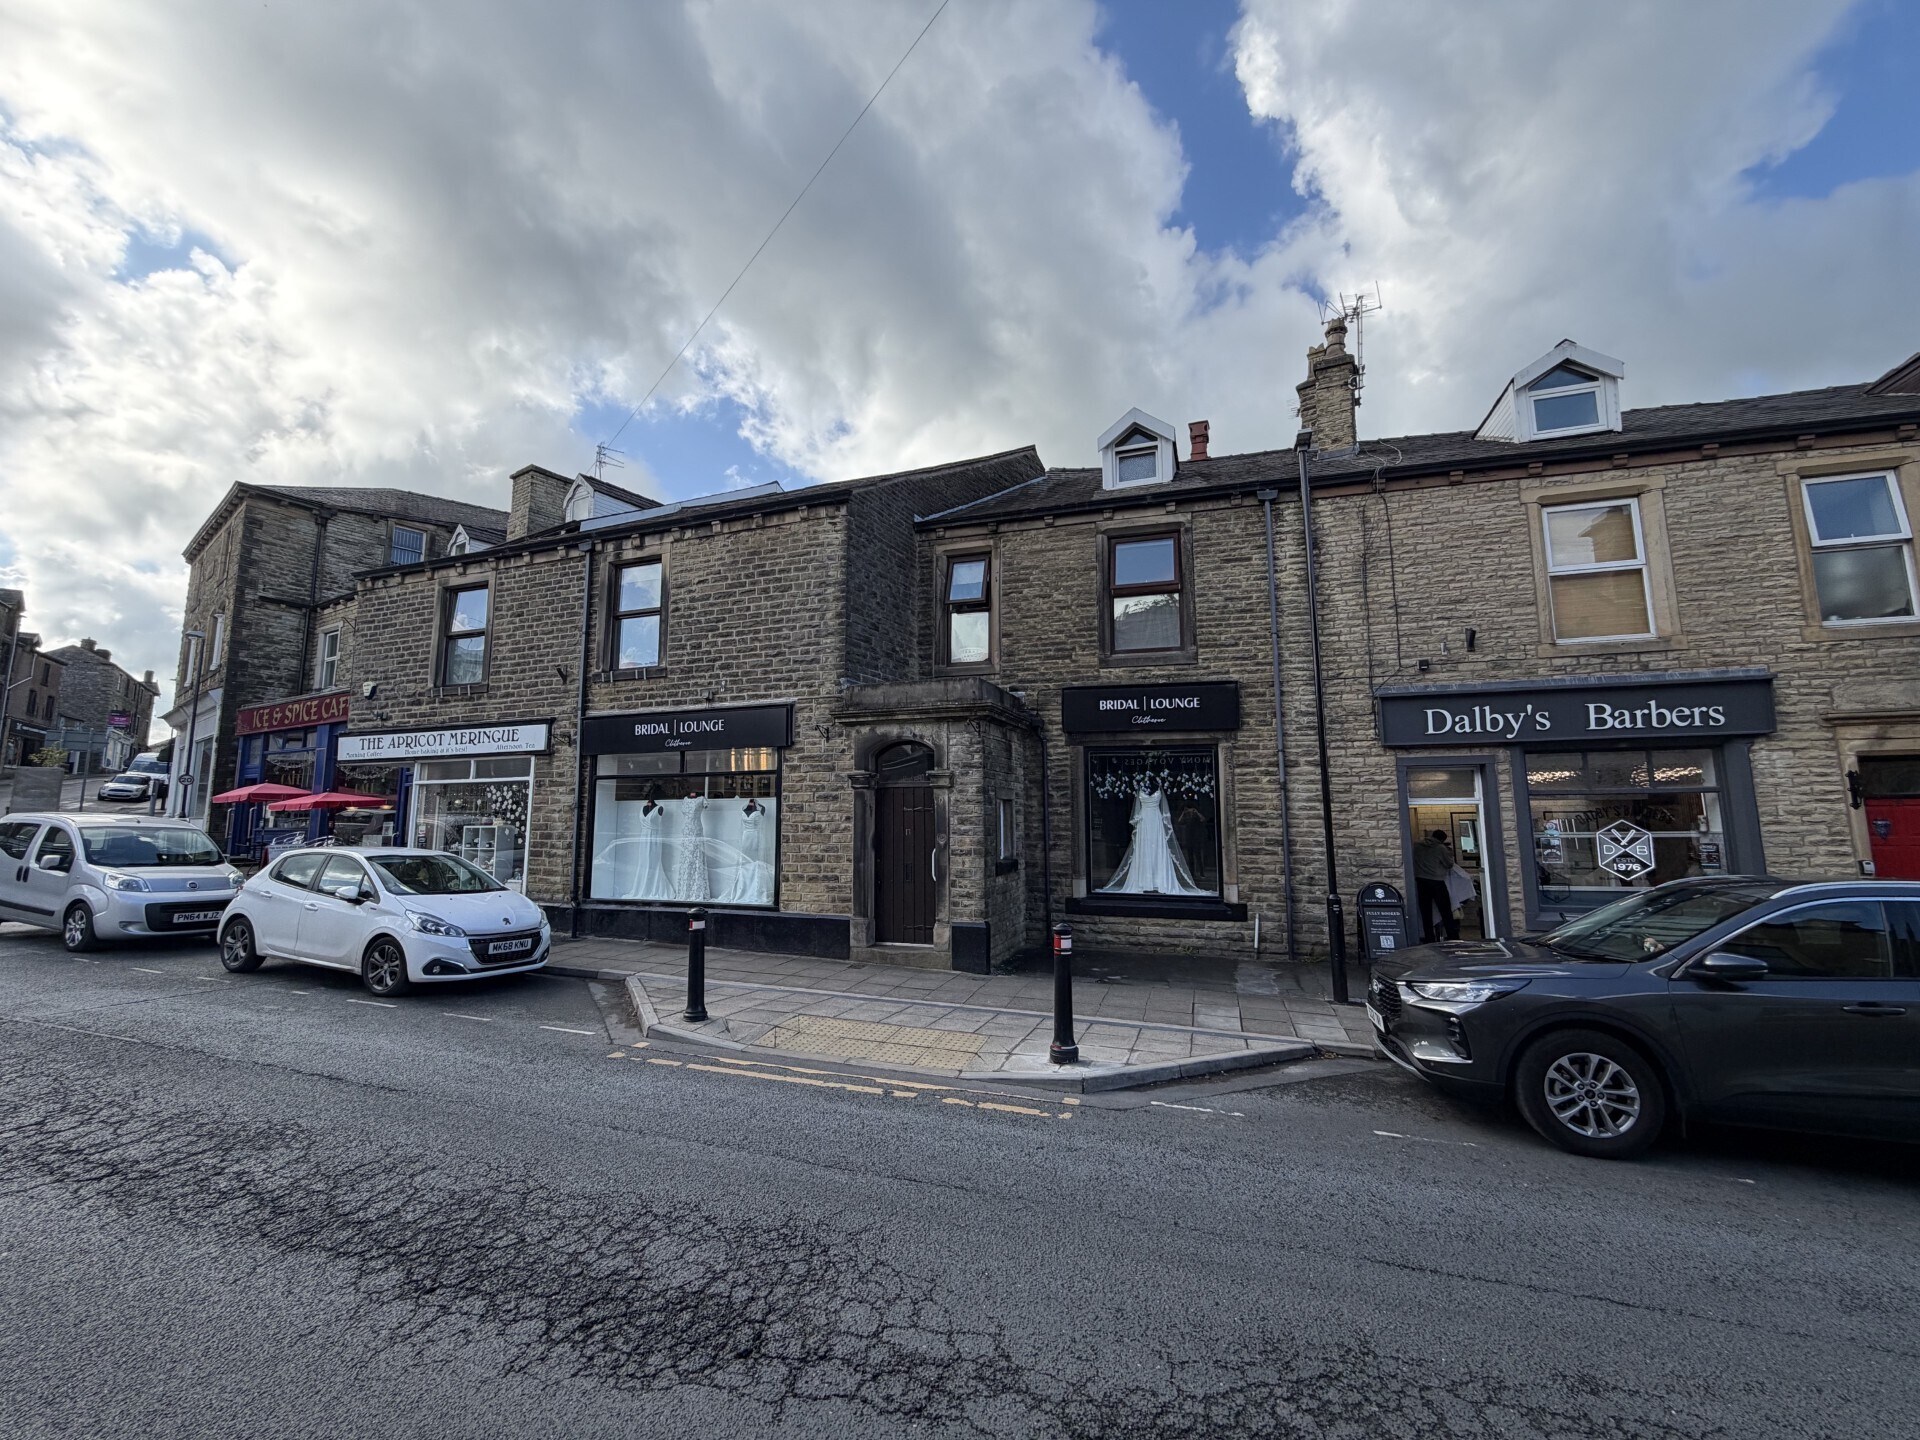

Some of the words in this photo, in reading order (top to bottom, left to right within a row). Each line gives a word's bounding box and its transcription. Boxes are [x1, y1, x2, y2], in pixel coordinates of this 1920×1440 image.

[1099, 699, 1140, 710] BRIDAL
[1150, 697, 1201, 709] LOUNGE
[252, 708, 270, 728] ICE
[272, 707, 283, 725] &
[284, 700, 319, 724] SPICE
[321, 696, 349, 719] CAF
[1423, 704, 1551, 739] Dalby's
[1585, 700, 1726, 731] Barbers
[634, 722, 670, 736] BRIDAL
[680, 719, 725, 733] LOUNGE
[359, 737, 384, 751] THE
[387, 733, 445, 749] APRICOT
[448, 728, 520, 746] MERINGUE
[1603, 844, 1615, 855] D
[1636, 845, 1648, 855] B
[1612, 862, 1641, 871] 1976
[177, 913, 200, 921] PN64
[203, 911, 220, 919] WJZ
[492, 941, 513, 952] MK68
